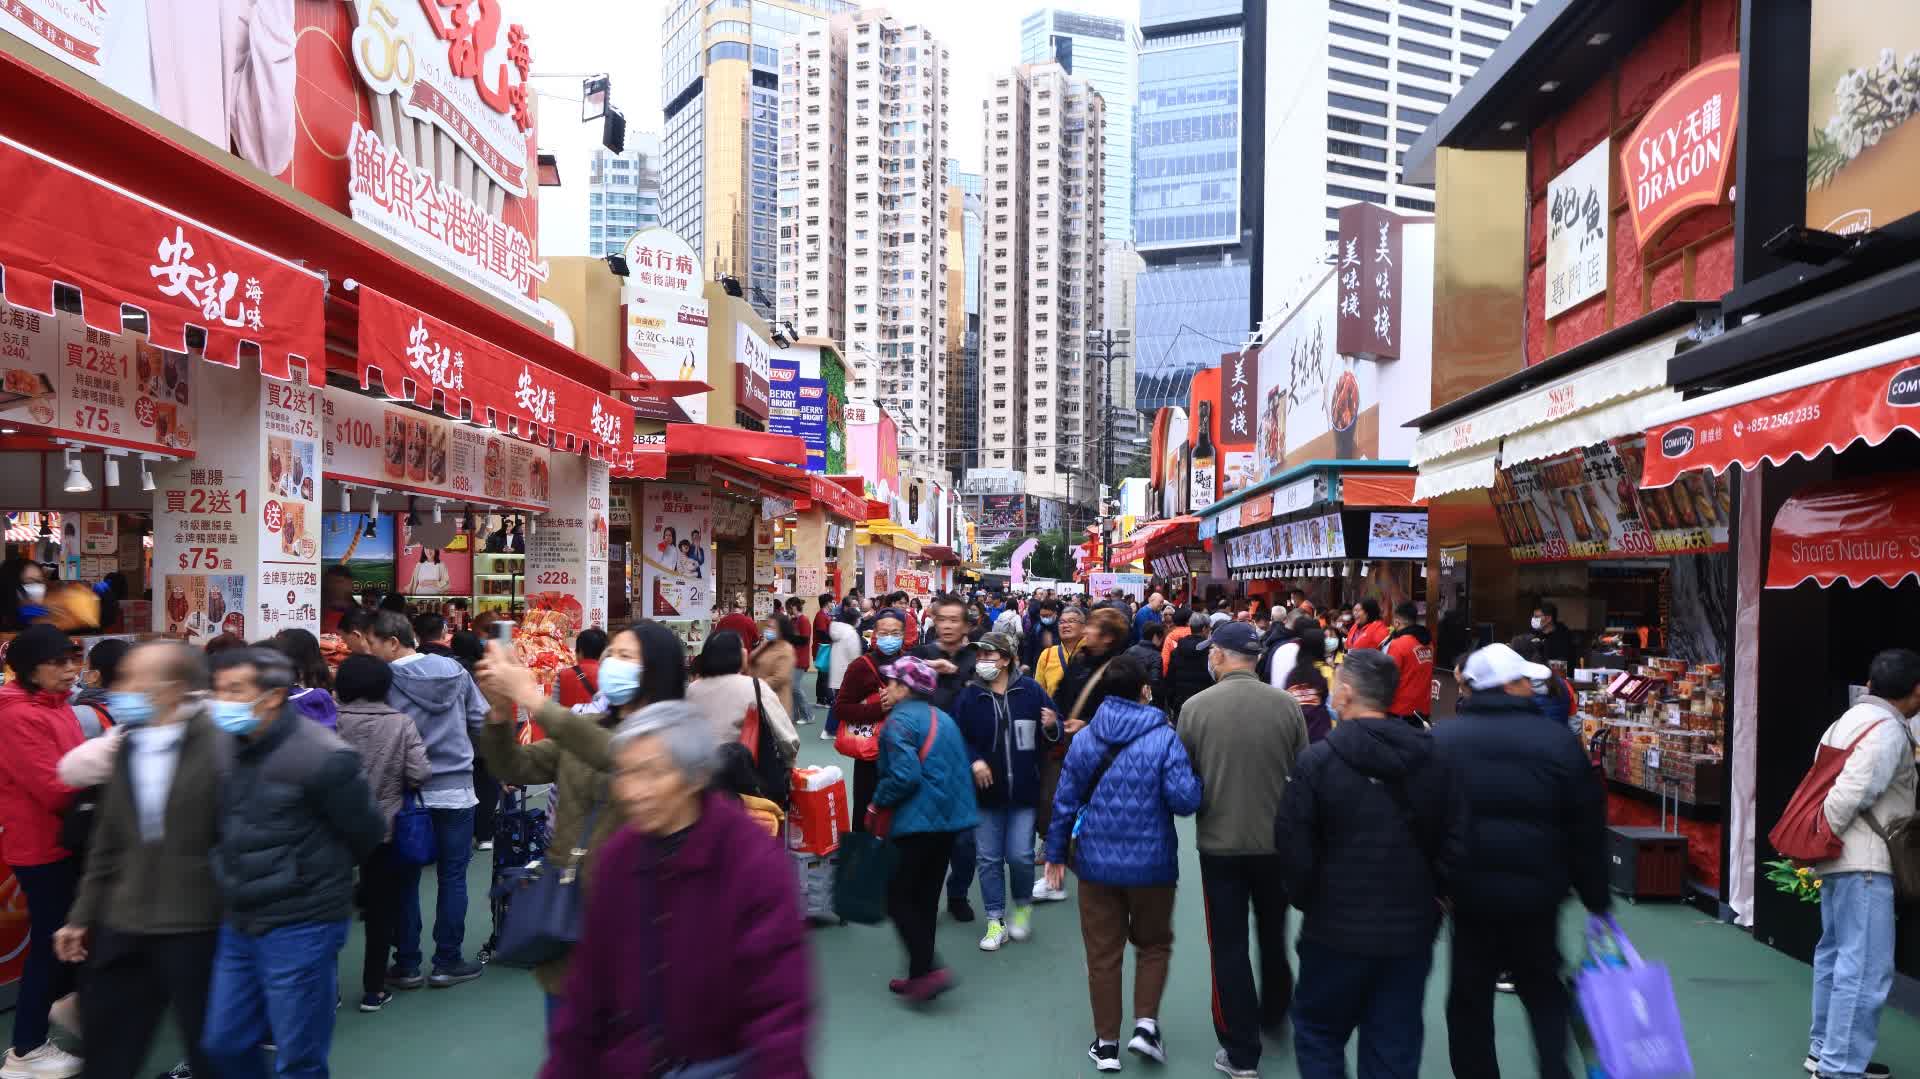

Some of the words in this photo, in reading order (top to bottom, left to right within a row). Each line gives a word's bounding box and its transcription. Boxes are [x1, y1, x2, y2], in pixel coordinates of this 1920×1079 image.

[1638, 120, 1682, 183] SKY
[1683, 94, 1722, 151] 天龍
[1637, 132, 1721, 213] DRAGON
[355, 133, 546, 290] 鮑魚全港銷量第一
[1551, 184, 1604, 253] 鮑魚
[635, 245, 693, 275] 流行病
[150, 226, 244, 327] 安記
[245, 277, 264, 331] 海味
[1340, 236, 1361, 319] 美味棧
[1373, 221, 1393, 347] 美味棧
[66, 343, 129, 378] 買2送1
[406, 317, 454, 388] 安記
[454, 351, 465, 391] 海味
[267, 383, 316, 416] 買2送1
[515, 364, 549, 424] 安記
[769, 390, 796, 399] BERRY
[771, 399, 796, 408] BRIGHT
[1230, 358, 1249, 436] 美味棧
[138, 400, 156, 425] 送
[591, 396, 615, 445] 安記
[1746, 416, 1769, 433] +852
[1770, 411, 1794, 429] 2562
[1795, 404, 1820, 424] 2335
[1664, 435, 1687, 449] COMVITA
[190, 468, 223, 486] 臘腸
[165, 488, 247, 515] 買2送1
[266, 504, 281, 530] 送
[1791, 540, 1834, 563] Share
[1839, 536, 1904, 560] Nature.
[263, 572, 317, 585] 金牌厚花菇2包
[263, 607, 317, 622] 尊尚一口菇1包
